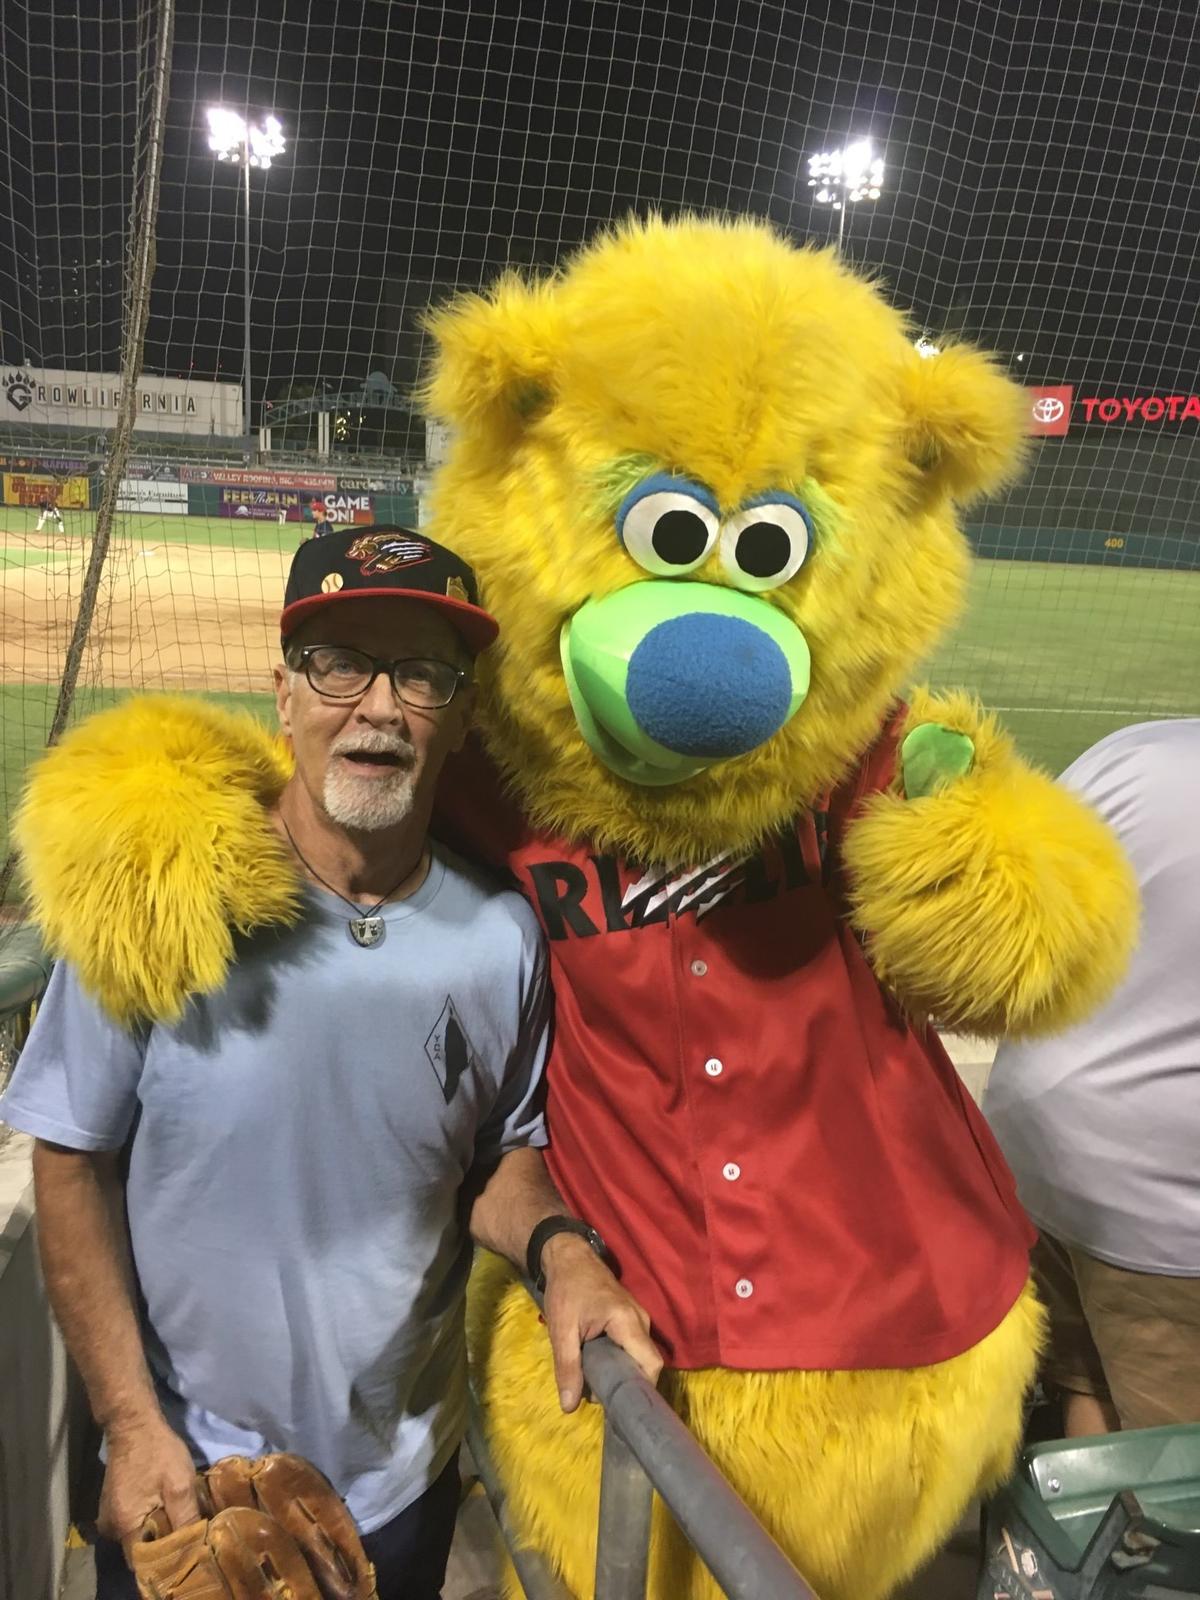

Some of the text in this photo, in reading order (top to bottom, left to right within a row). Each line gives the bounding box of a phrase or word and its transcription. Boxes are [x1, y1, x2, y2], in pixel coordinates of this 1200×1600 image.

[7, 383, 195, 412] GROWLIFRNIA
[1082, 396, 1200, 421] TOYOTA
[213, 472, 241, 482] VALLEY
[324, 495, 370, 510] GAME
[326, 509, 354, 523] ON!
[1105, 538, 1124, 549] 400
